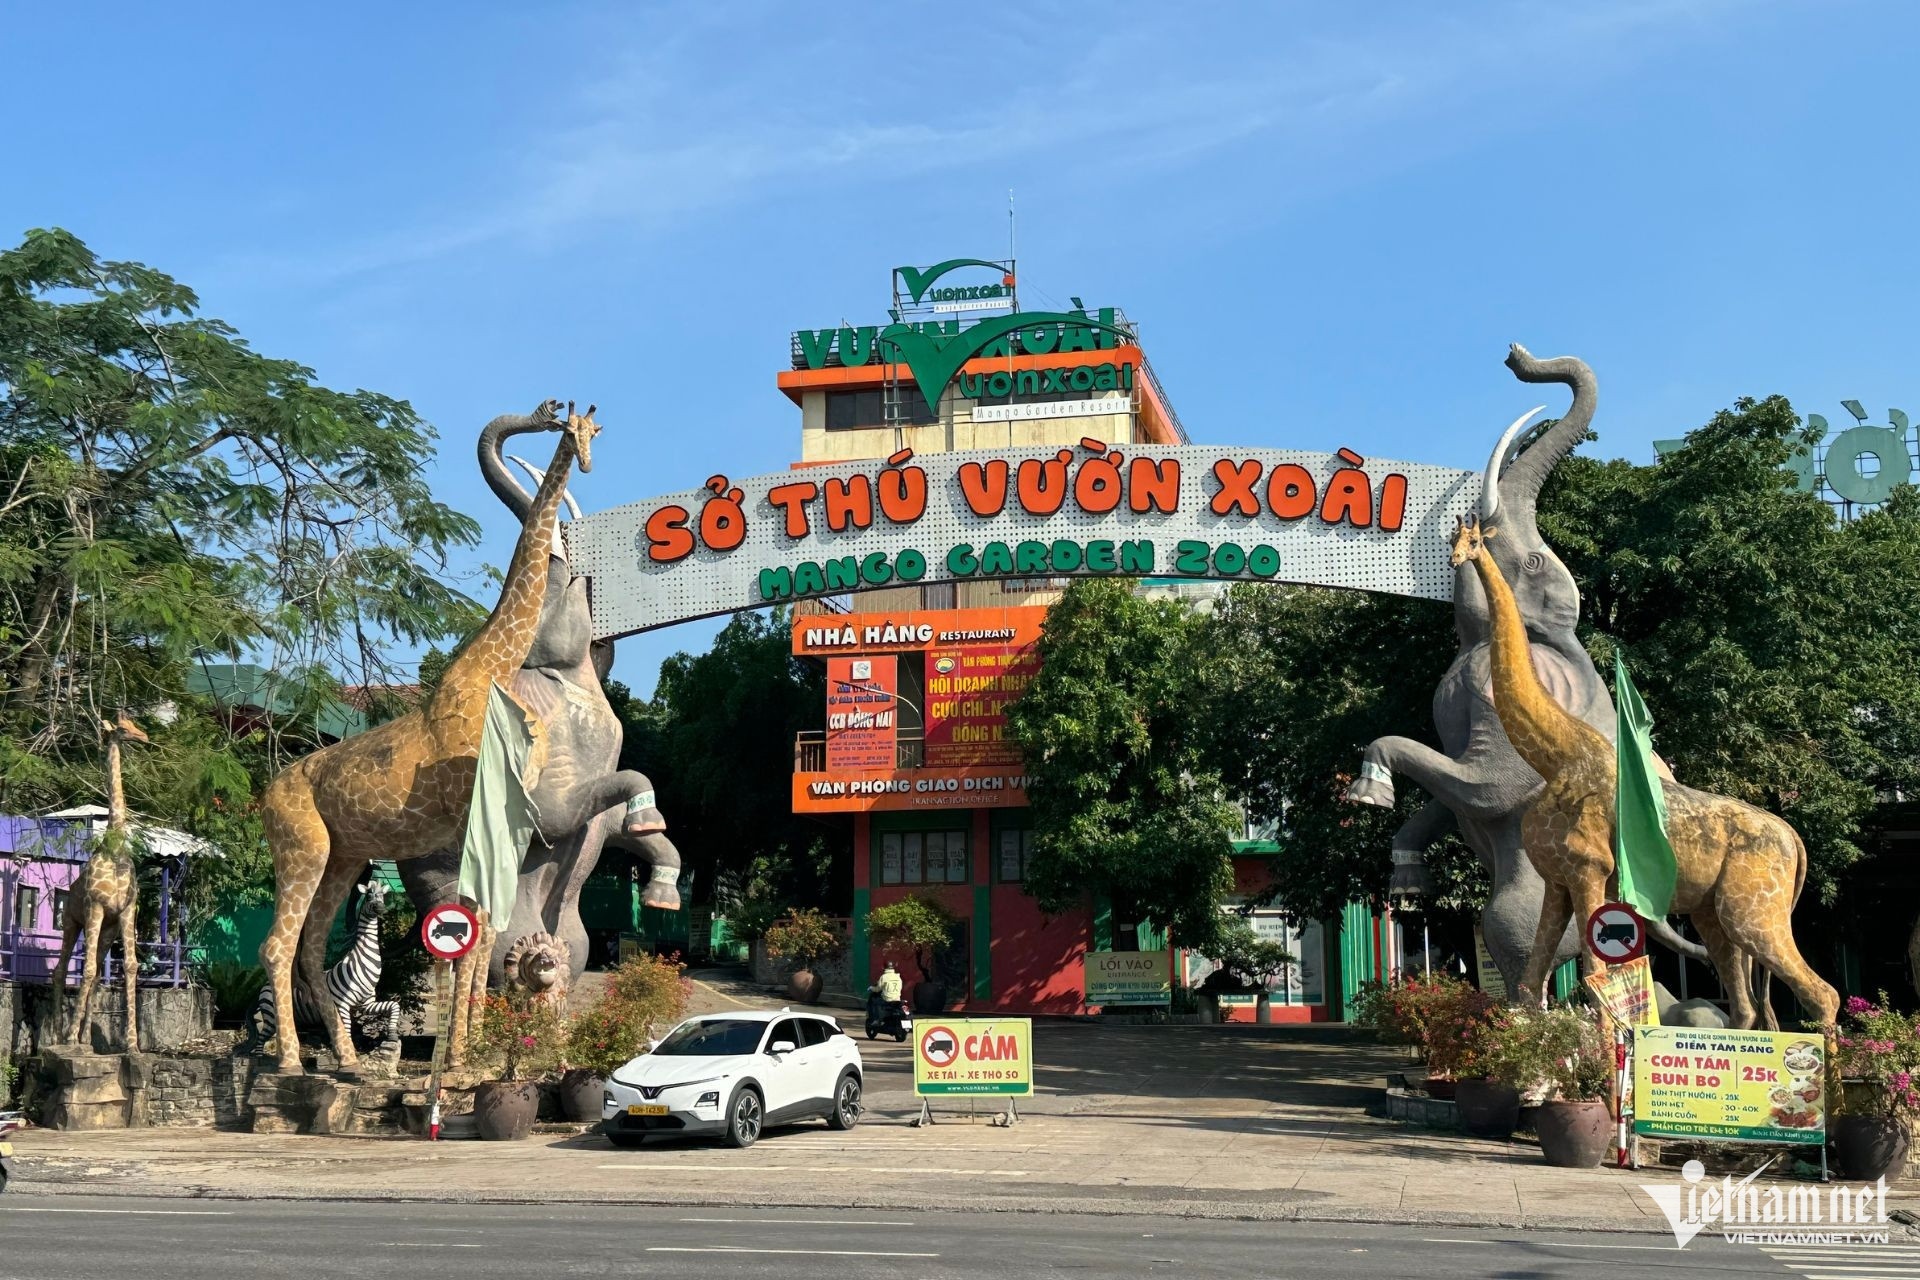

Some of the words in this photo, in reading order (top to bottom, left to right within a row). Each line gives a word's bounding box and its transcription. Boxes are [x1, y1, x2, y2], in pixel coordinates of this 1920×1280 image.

[1080, 401, 1126, 413] Resort
[645, 474, 747, 563] SỞ
[768, 447, 928, 538] THÚ
[958, 437, 1181, 518] VƯỜN
[1210, 447, 1409, 532] XOÀI
[758, 548, 927, 600] MANGO
[946, 538, 1155, 577] GARDEN
[1175, 540, 1282, 578] ZOO
[806, 621, 858, 646] NHÀ
[865, 620, 934, 644] HÀNG
[939, 628, 1017, 641] RESTAURANT
[929, 674, 951, 697] HỘI
[954, 676, 998, 694] DOANH
[829, 712, 846, 730] CCB
[875, 711, 893, 728] NAI
[850, 777, 912, 794] PHÒNG
[916, 777, 959, 793] GIAO
[963, 776, 1004, 795] DỊCH
[912, 796, 966, 805] TRANSACTION
[964, 1026, 1018, 1061] CẤM
[1651, 1055, 1689, 1068] CƠM
[927, 1071, 940, 1080] XE
[967, 1070, 980, 1080] XE
[1742, 1066, 1778, 1082] 25K
